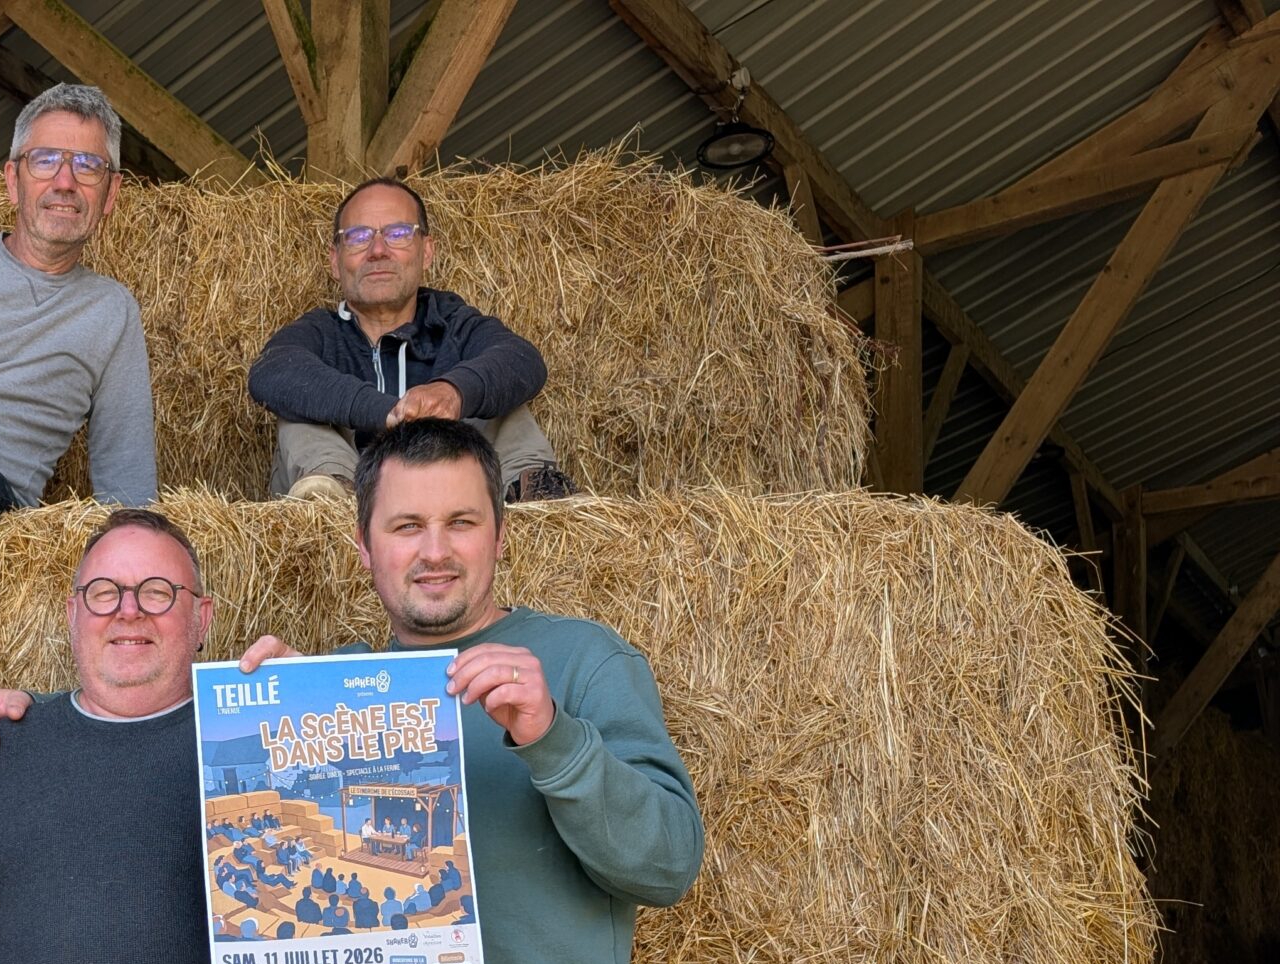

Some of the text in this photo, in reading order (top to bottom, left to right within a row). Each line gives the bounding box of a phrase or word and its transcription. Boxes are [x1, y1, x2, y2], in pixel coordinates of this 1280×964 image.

[213, 675, 281, 708] TEILLÉ
[343, 676, 376, 689] SHAKER
[260, 698, 440, 749] LA SCÈNE EST
[271, 721, 437, 772] DANS LE PRÉ
[346, 767, 372, 777] SPECTACLE
[384, 764, 400, 772] FERME
